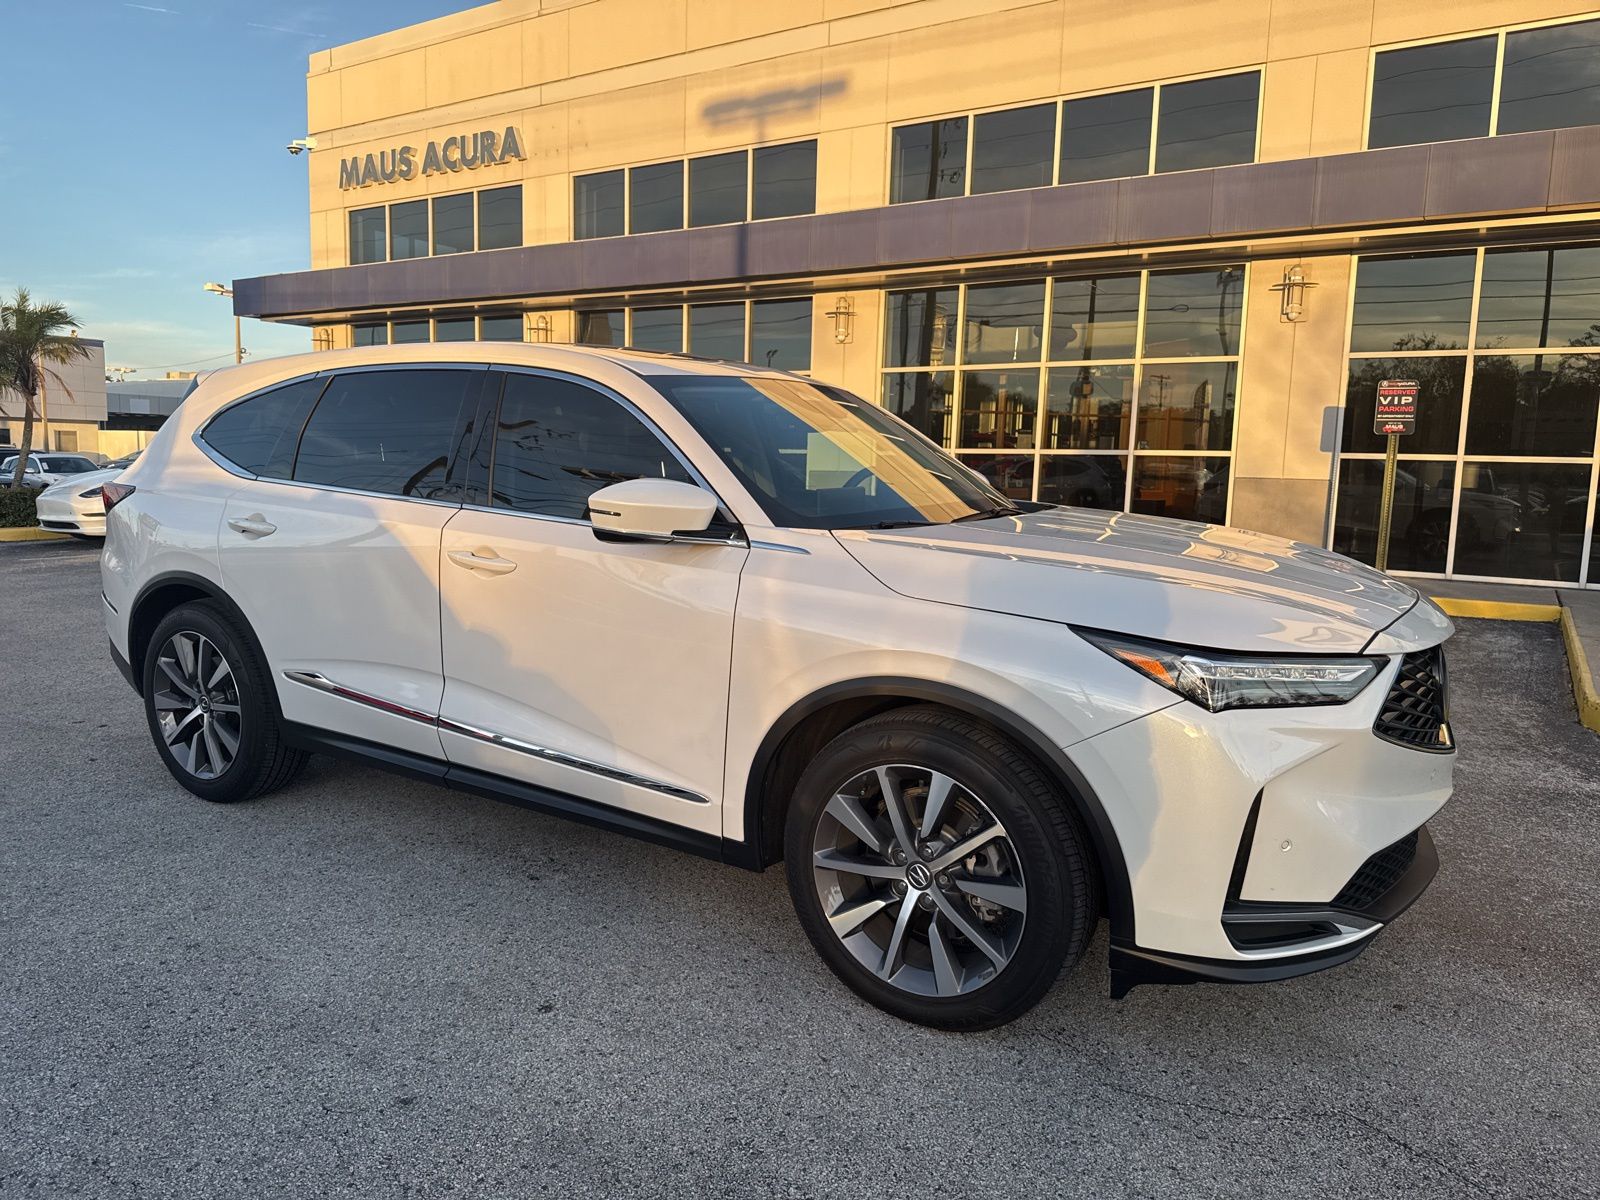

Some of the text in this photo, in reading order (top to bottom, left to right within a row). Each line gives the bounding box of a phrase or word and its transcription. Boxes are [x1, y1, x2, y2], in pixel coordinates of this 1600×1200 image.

[339, 126, 525, 190] MAUS ACURA
[1379, 396, 1413, 405] VIP
